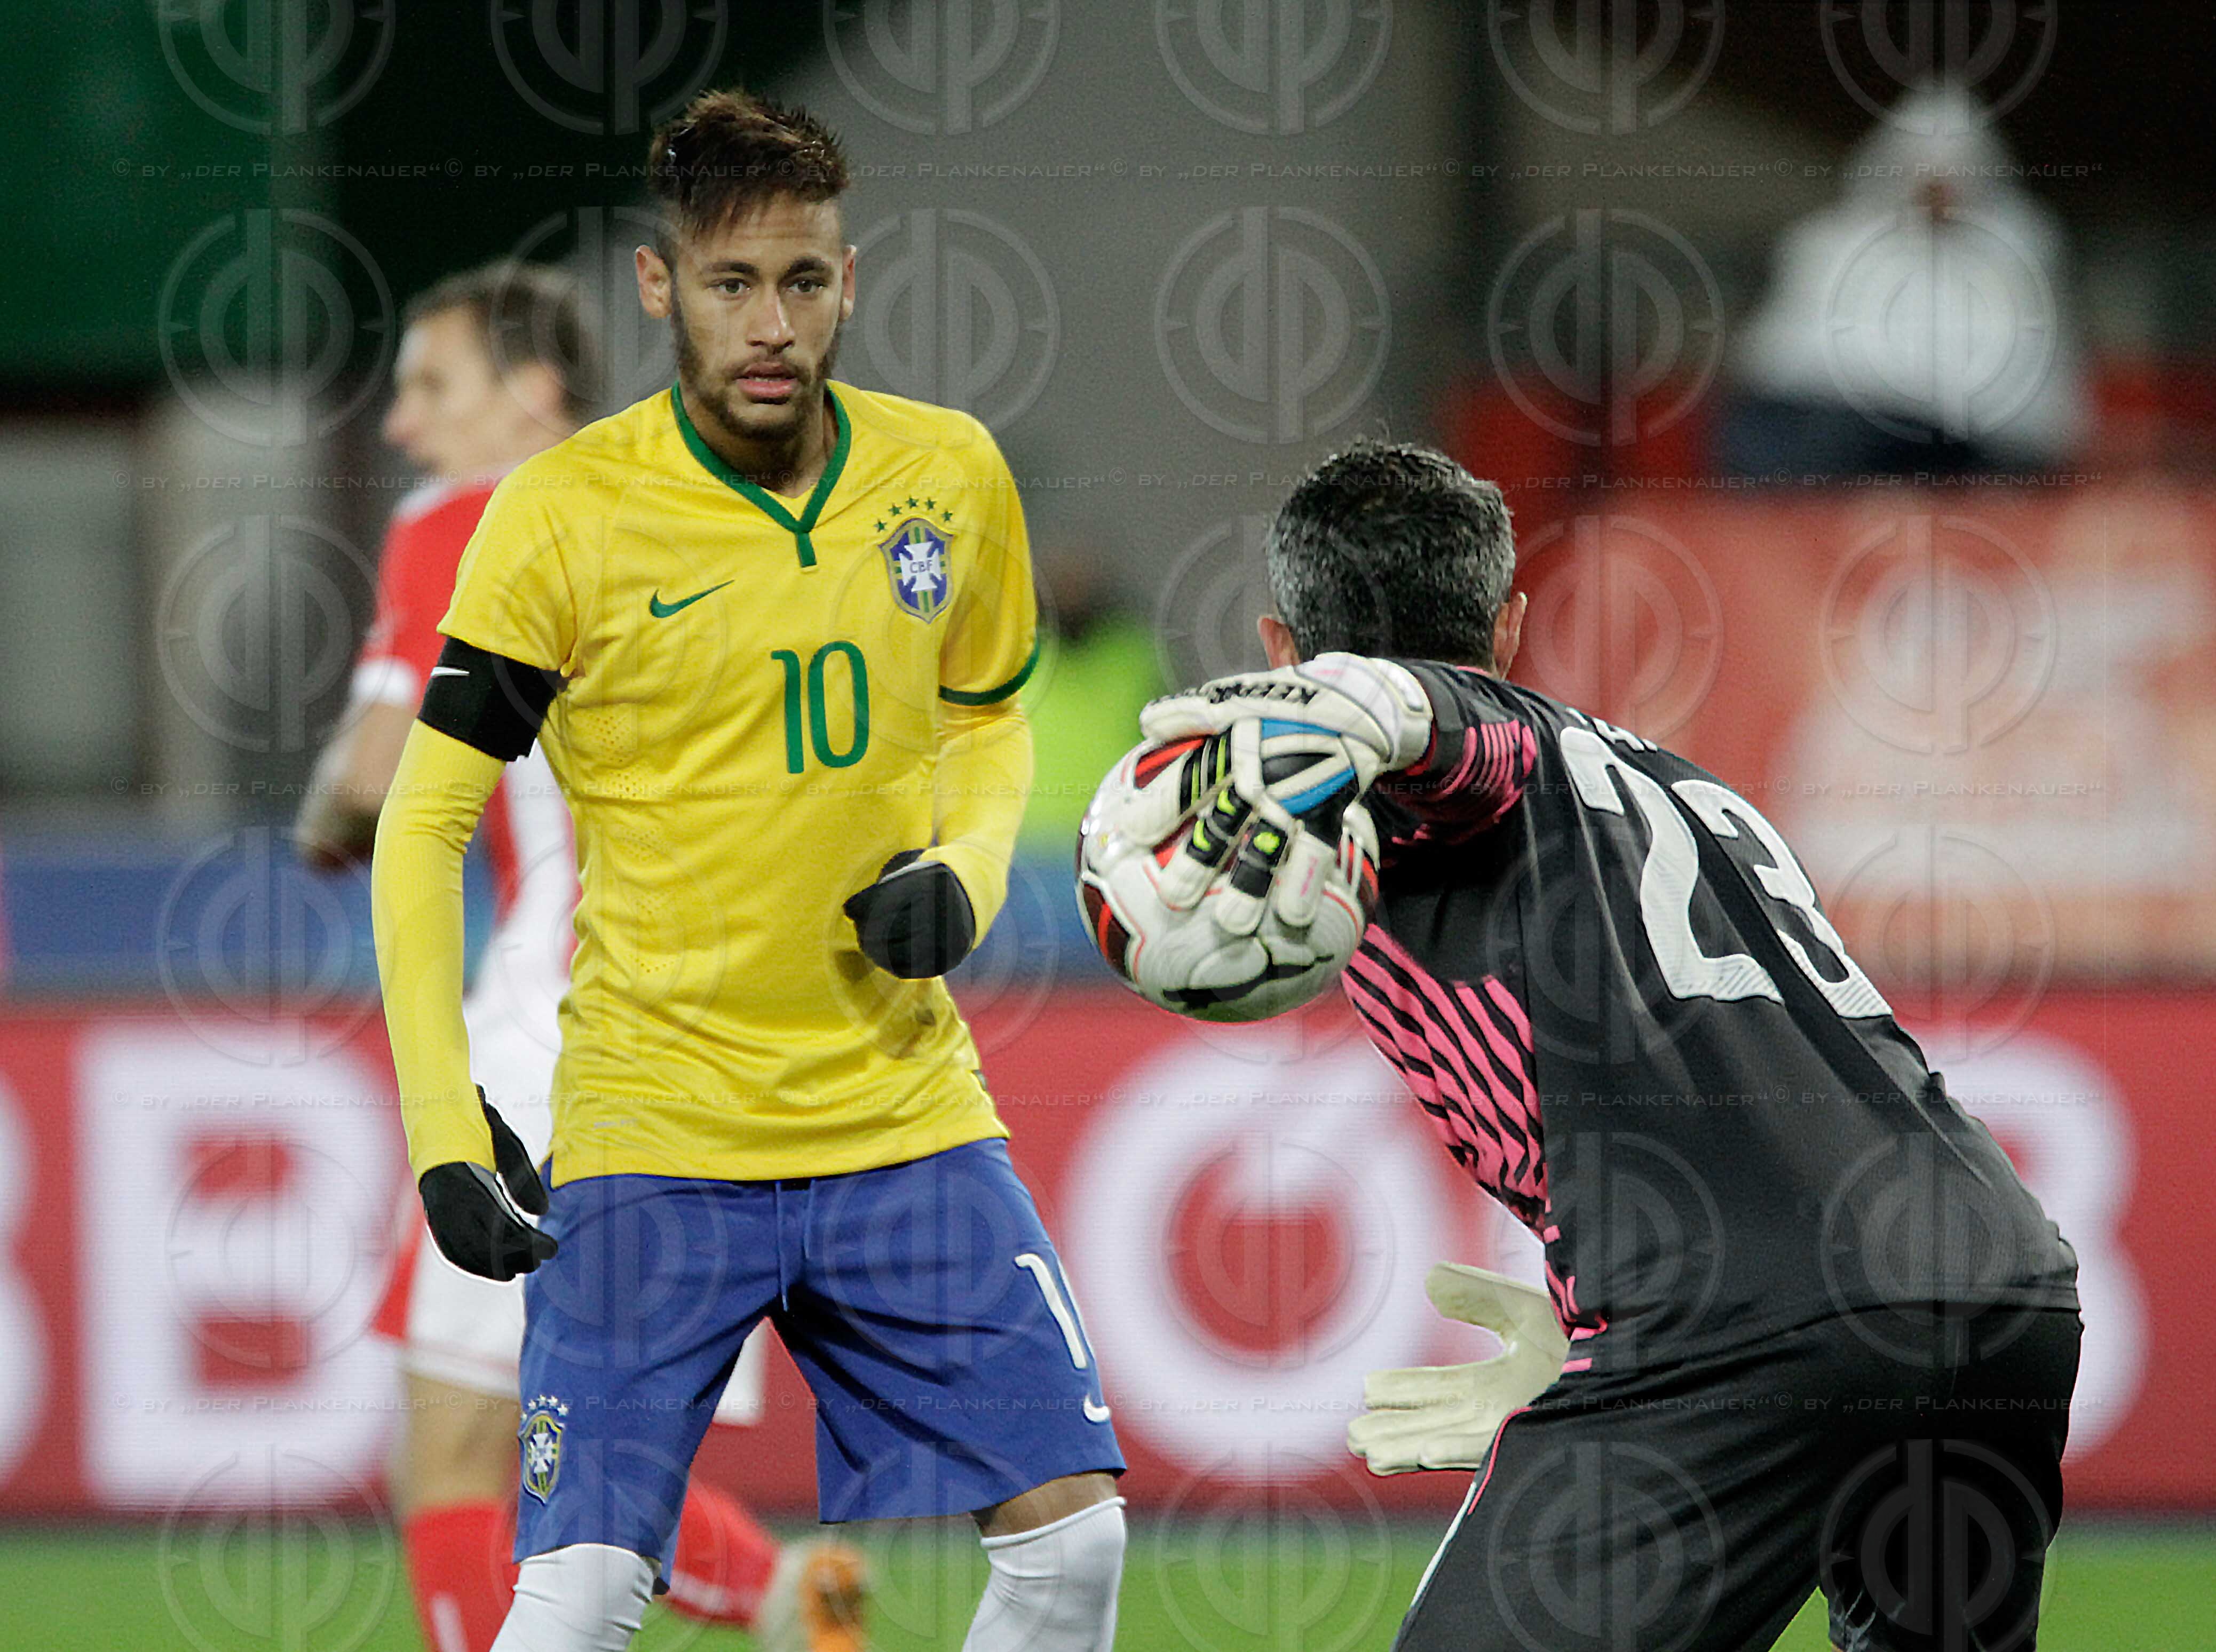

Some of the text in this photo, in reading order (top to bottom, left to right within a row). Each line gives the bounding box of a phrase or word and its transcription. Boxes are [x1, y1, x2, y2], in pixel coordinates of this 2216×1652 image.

[909, 559, 933, 574] CBF
[771, 640, 869, 774] 10
[1560, 726, 1893, 1020] 23
